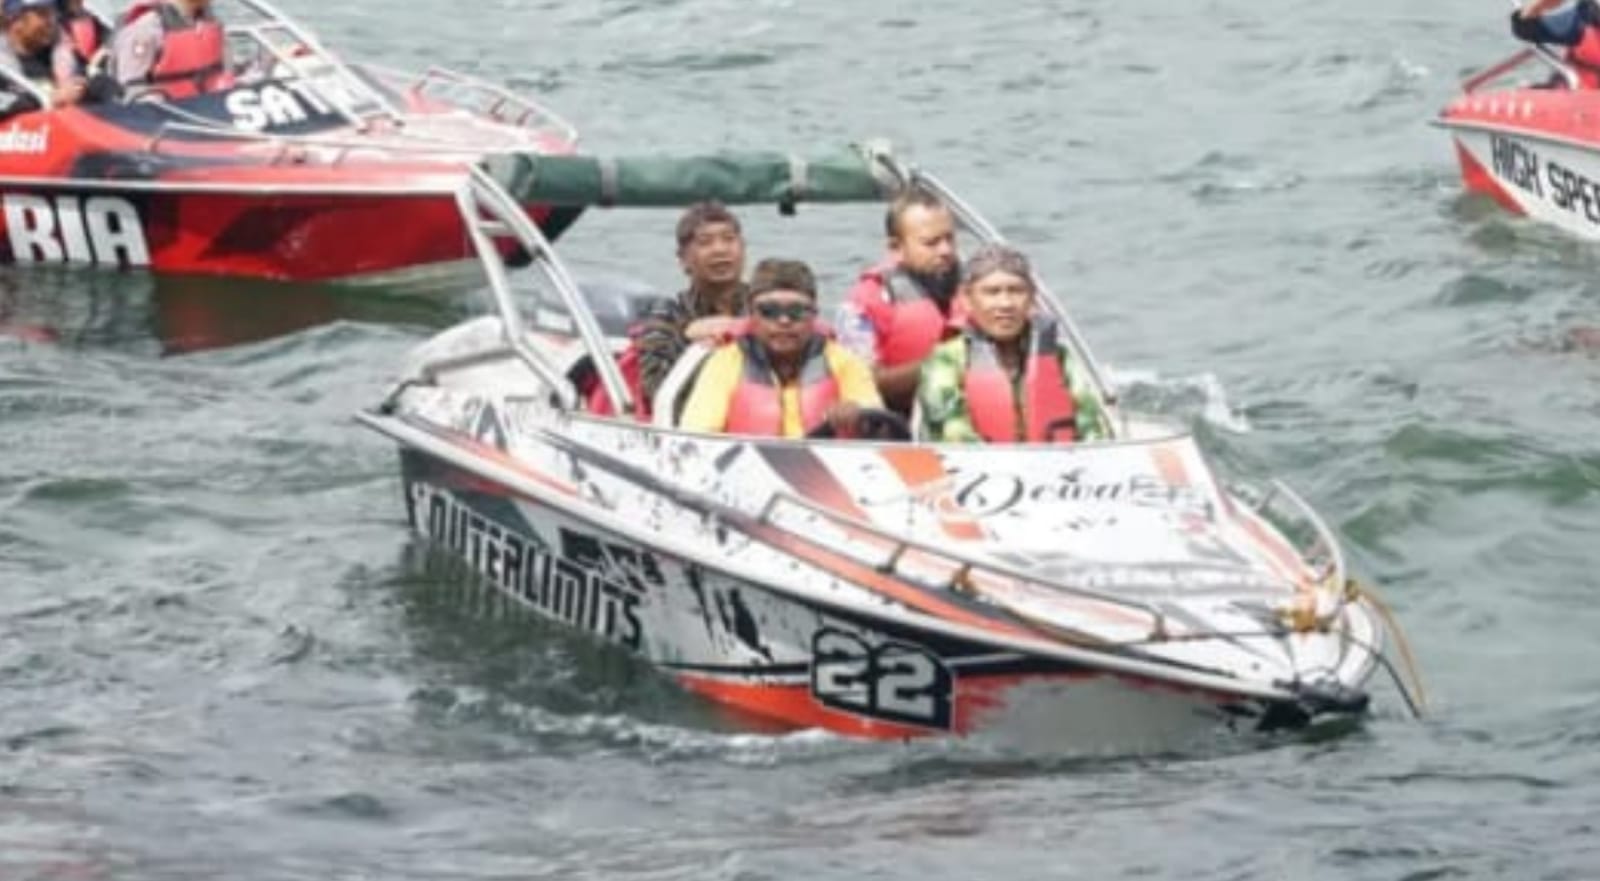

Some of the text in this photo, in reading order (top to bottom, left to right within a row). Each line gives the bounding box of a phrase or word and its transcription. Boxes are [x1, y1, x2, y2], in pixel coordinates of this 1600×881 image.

[1489, 132, 1543, 199] HIGH
[3, 194, 151, 266] RIA
[814, 631, 938, 721] 22
